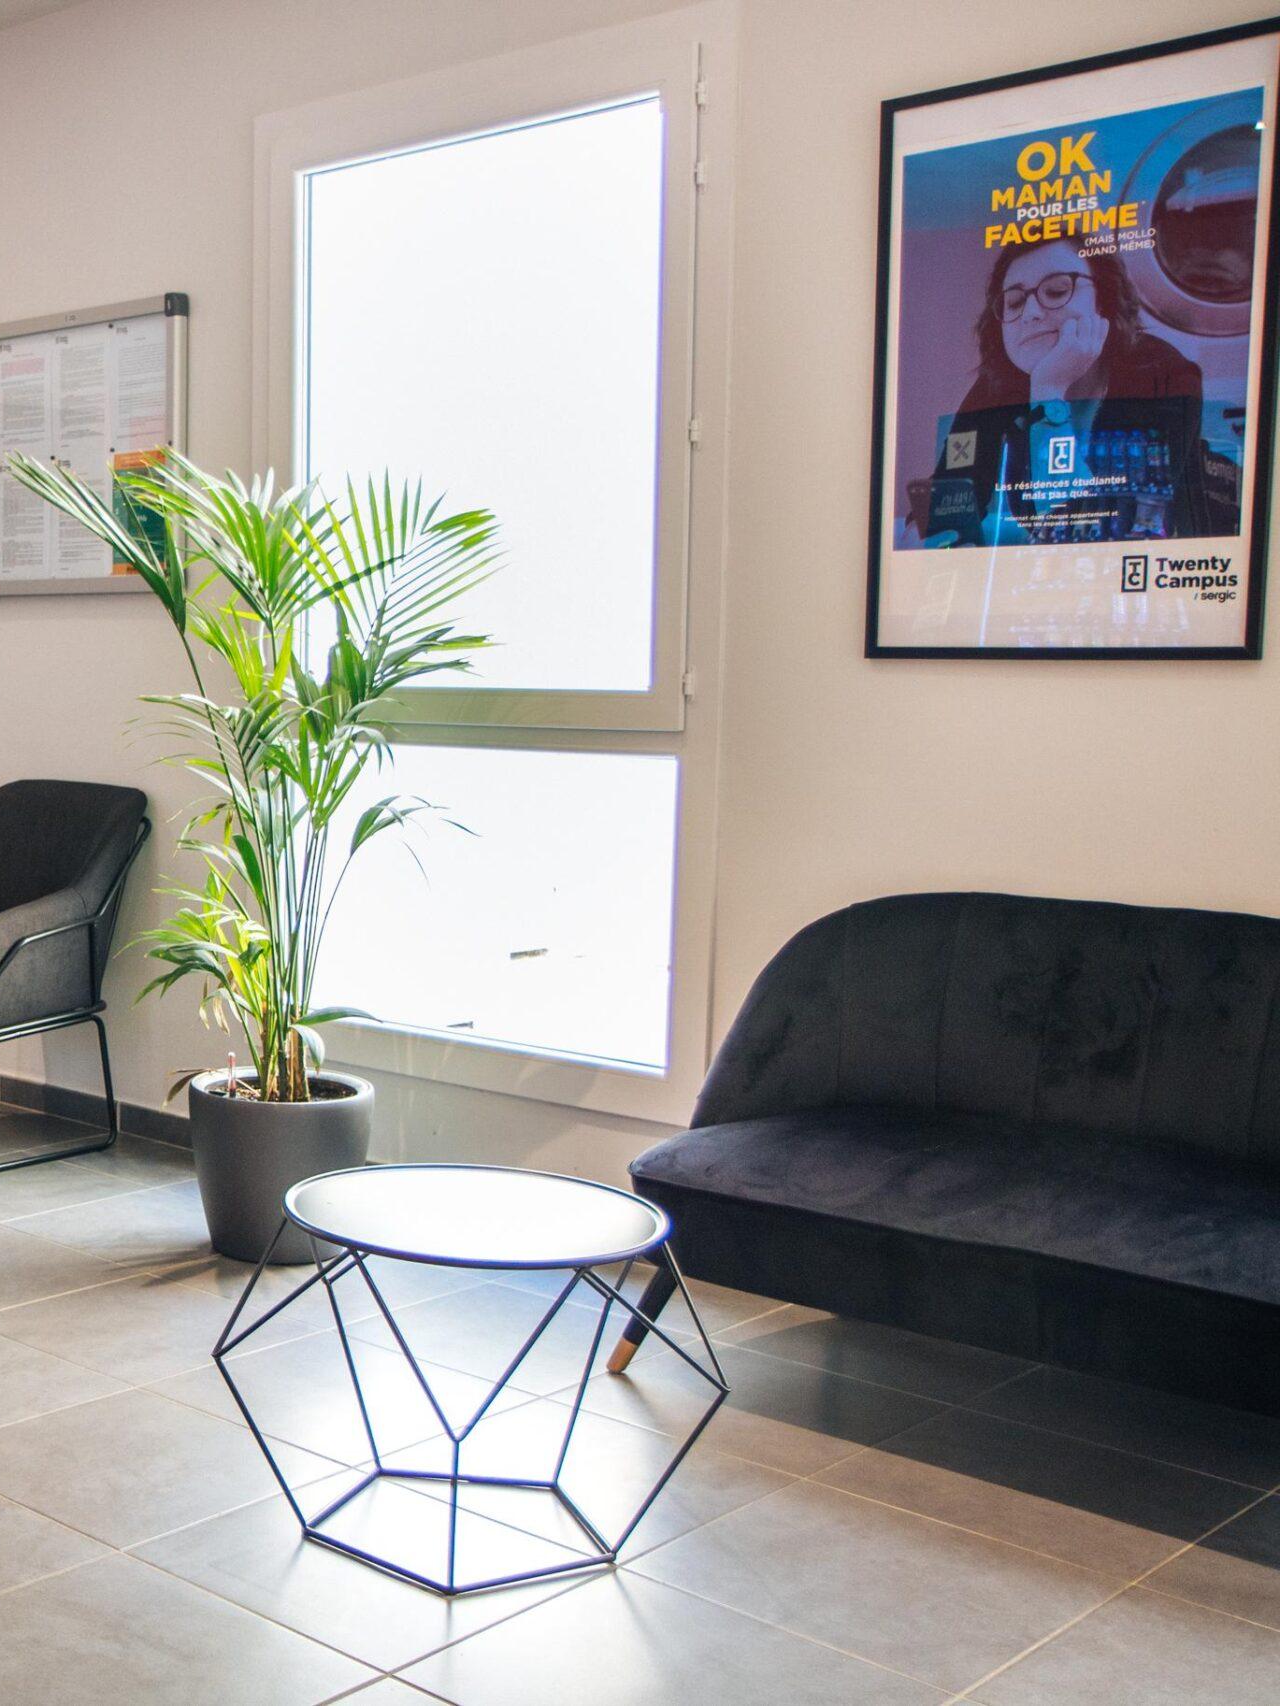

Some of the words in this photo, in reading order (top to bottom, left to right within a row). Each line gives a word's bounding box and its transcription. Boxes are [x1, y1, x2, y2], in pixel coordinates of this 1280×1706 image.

[1016, 131, 1097, 182] OK
[991, 169, 1111, 212] MAMAN
[1016, 204, 1063, 221] POUR
[1067, 196, 1098, 213] LES
[1084, 234, 1114, 248] (MAIS
[1117, 228, 1156, 241] MOLLO
[1078, 245, 1117, 258] QUAND
[1119, 238, 1156, 252] MÊME)
[995, 482, 1012, 491] Les
[1014, 479, 1070, 490] résidences
[1072, 475, 1127, 487] étudiantes
[1022, 491, 1046, 500] mais
[1049, 490, 1067, 501] pas
[1155, 556, 1231, 573] Twenty
[1154, 573, 1238, 590] Campus
[1200, 589, 1237, 603] sergic
